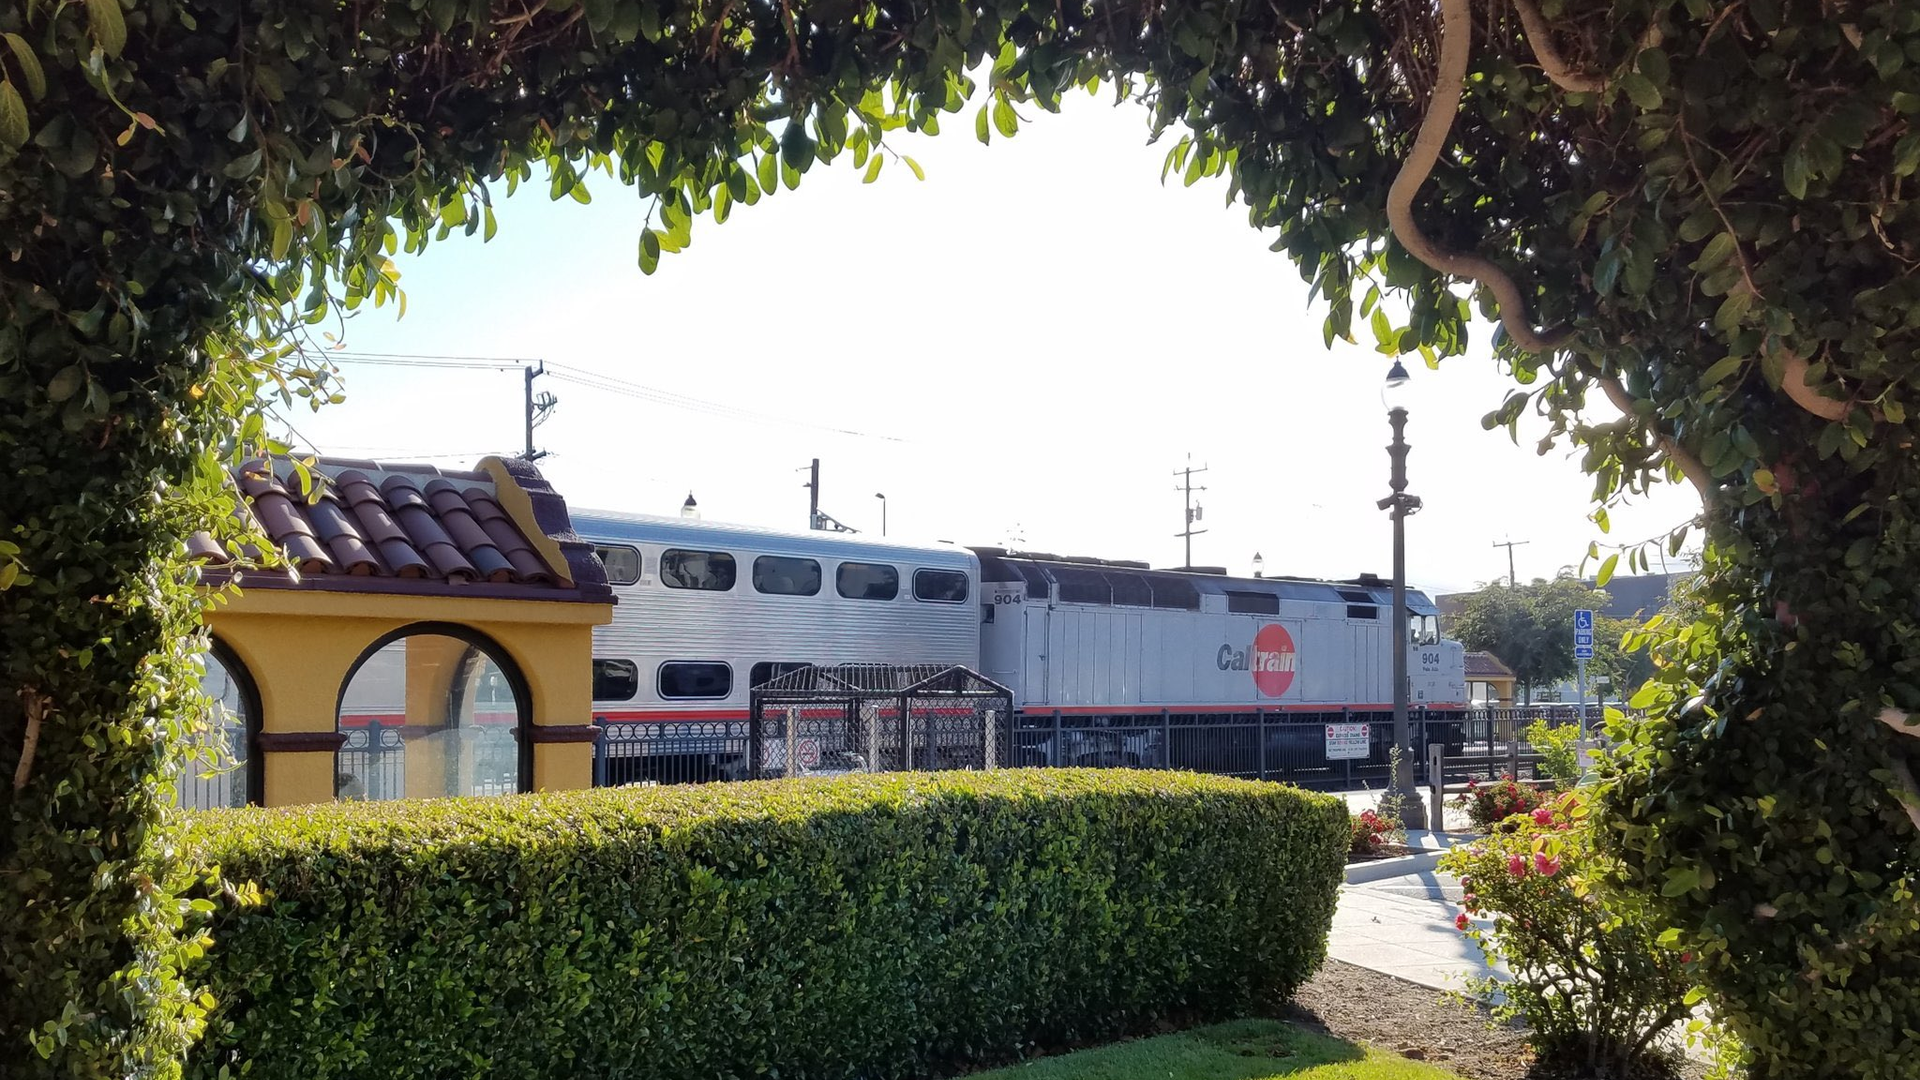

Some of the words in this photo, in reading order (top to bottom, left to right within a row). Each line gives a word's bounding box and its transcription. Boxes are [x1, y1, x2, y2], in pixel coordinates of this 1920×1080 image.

[994, 594, 1021, 605] 904
[1216, 643, 1297, 672] Caltrain
[1422, 652, 1440, 665] 904
